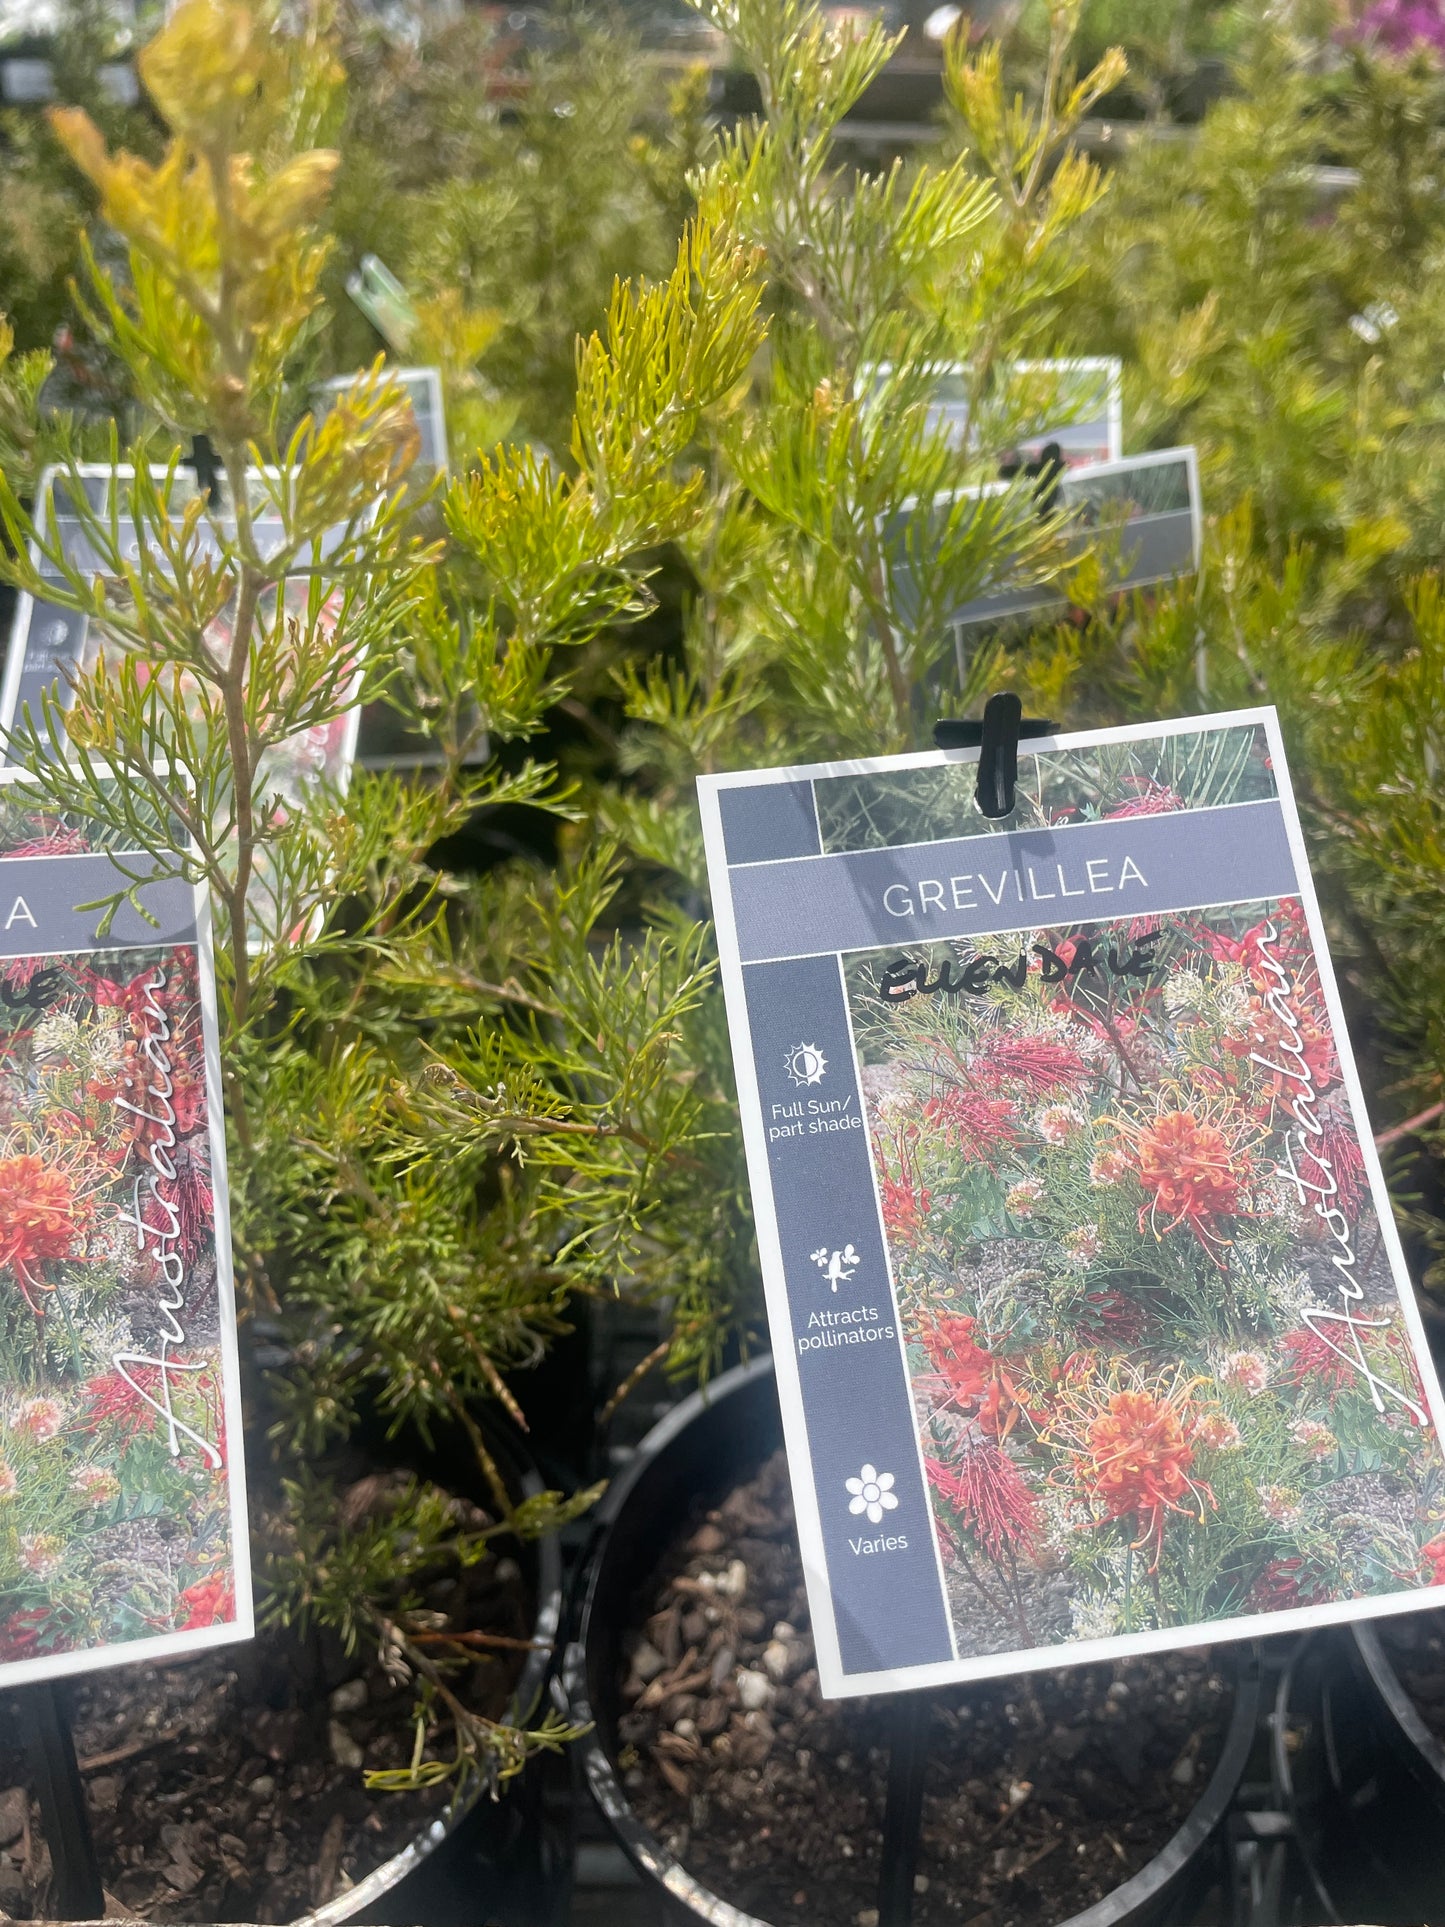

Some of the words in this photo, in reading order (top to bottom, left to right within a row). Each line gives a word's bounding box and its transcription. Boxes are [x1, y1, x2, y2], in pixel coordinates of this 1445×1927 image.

[882, 855, 1149, 918] GREVILLEA
[771, 1100, 805, 1120] Full
[807, 1095, 852, 1116] Sun/
[768, 1121, 805, 1143] part
[809, 1114, 862, 1135] shade
[1249, 919, 1429, 1427] Australian
[112, 965, 222, 1469] Australian
[807, 1306, 879, 1329] Attracts
[798, 1324, 895, 1355] pollinators
[848, 1535, 909, 1556] Varies
